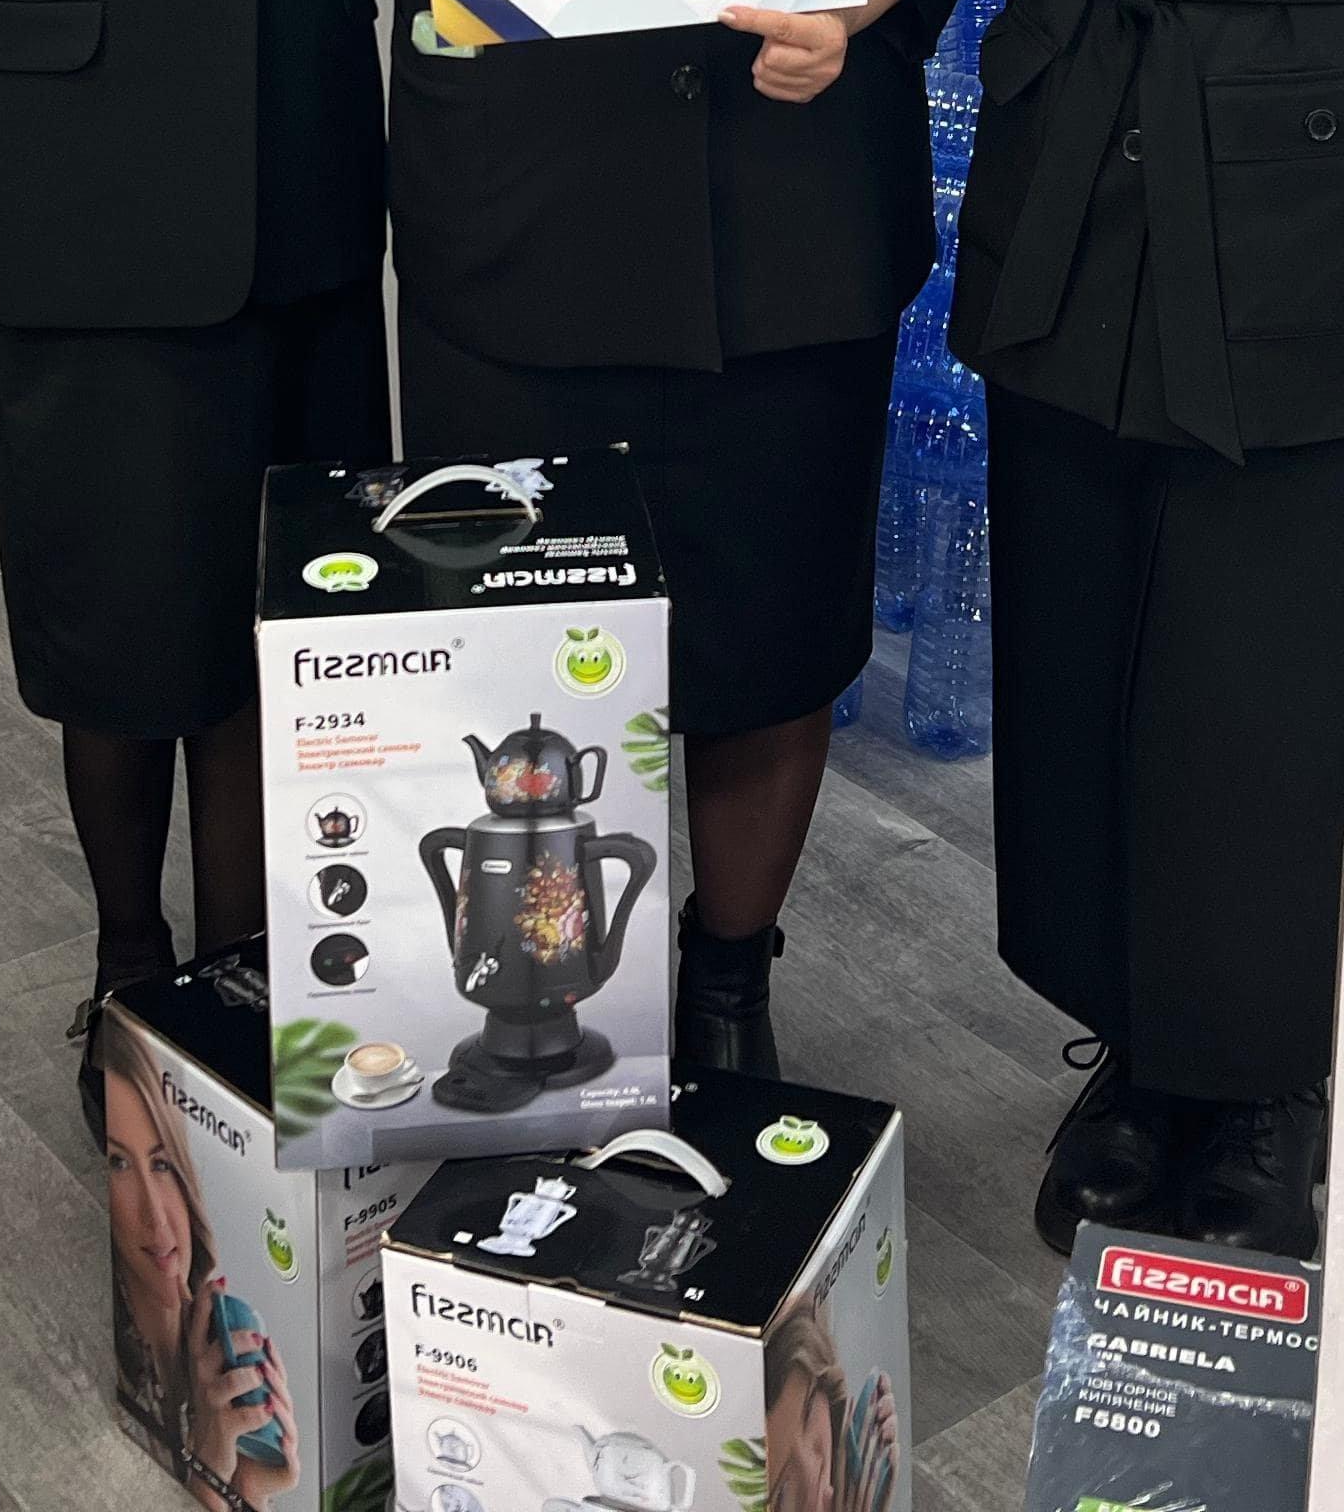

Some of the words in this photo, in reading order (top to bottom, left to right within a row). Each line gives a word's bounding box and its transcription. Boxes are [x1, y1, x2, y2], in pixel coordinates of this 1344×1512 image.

[295, 711, 366, 732] F-2934
[344, 1192, 398, 1232] F-9905
[1094, 1297, 1319, 1352] ЧАЙНИК-ТЕРМОС
[415, 1343, 478, 1373] F-9906
[1087, 1332, 1236, 1373] GABRIELA
[1078, 1389, 1177, 1419] КИПЯЧЕНИЕ
[1083, 1374, 1178, 1404] ПОВТОРНОЕ
[1074, 1405, 1162, 1439] F5800
